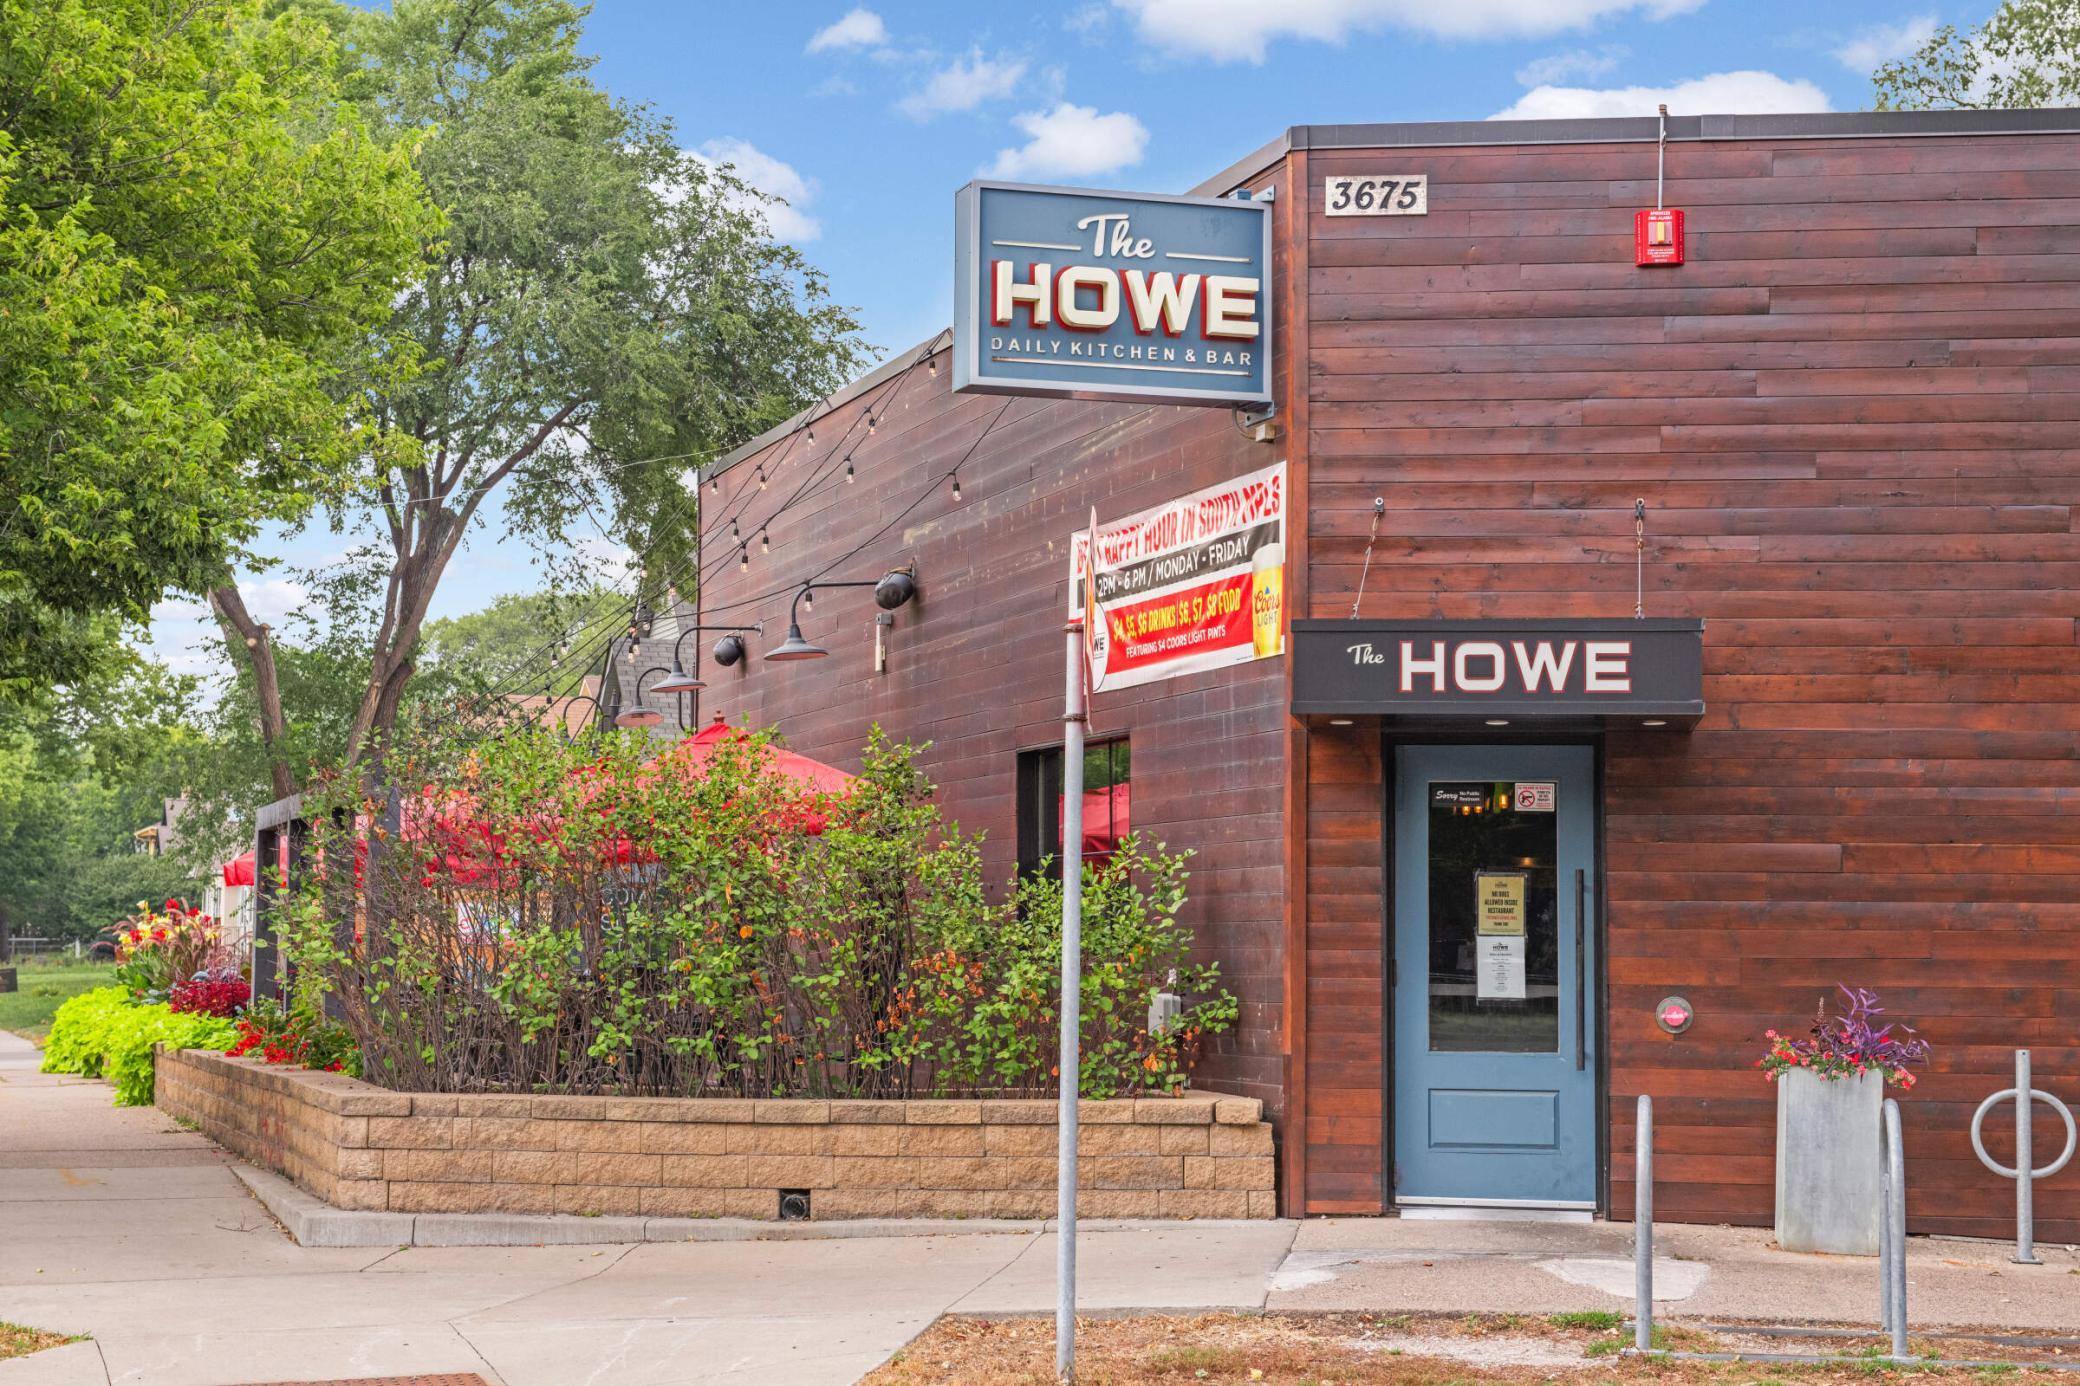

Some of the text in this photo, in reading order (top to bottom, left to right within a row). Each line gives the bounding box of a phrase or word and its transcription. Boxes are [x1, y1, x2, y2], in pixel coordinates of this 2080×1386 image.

[1332, 180, 1422, 210] 3675
[1077, 213, 1155, 259] The
[991, 260, 1260, 343] HOWE
[991, 336, 1251, 366] DAILY KITCHEN & BAR
[1104, 523, 1145, 565] HAPPY
[1144, 511, 1178, 555] HOUR
[1181, 505, 1196, 544] IN
[1199, 490, 1241, 538] SOUTH
[1242, 475, 1280, 524] MPLS
[1124, 572, 1131, 590] 6
[1132, 566, 1146, 588] PM
[1155, 550, 1200, 581] MONDAY
[1208, 534, 1250, 566] FRIDAY
[1148, 605, 1176, 632] DRINKS
[1218, 587, 1241, 615] FOOD
[1254, 590, 1280, 614] Coors
[1257, 611, 1278, 627] LIGHT
[1126, 640, 1158, 659] FEATURING
[1166, 634, 1187, 650] COORS
[1188, 628, 1206, 645] LIGHT
[1207, 624, 1226, 640] PINTS
[1346, 639, 1633, 694] The HOWE
[1435, 790, 1458, 801] Sorry
